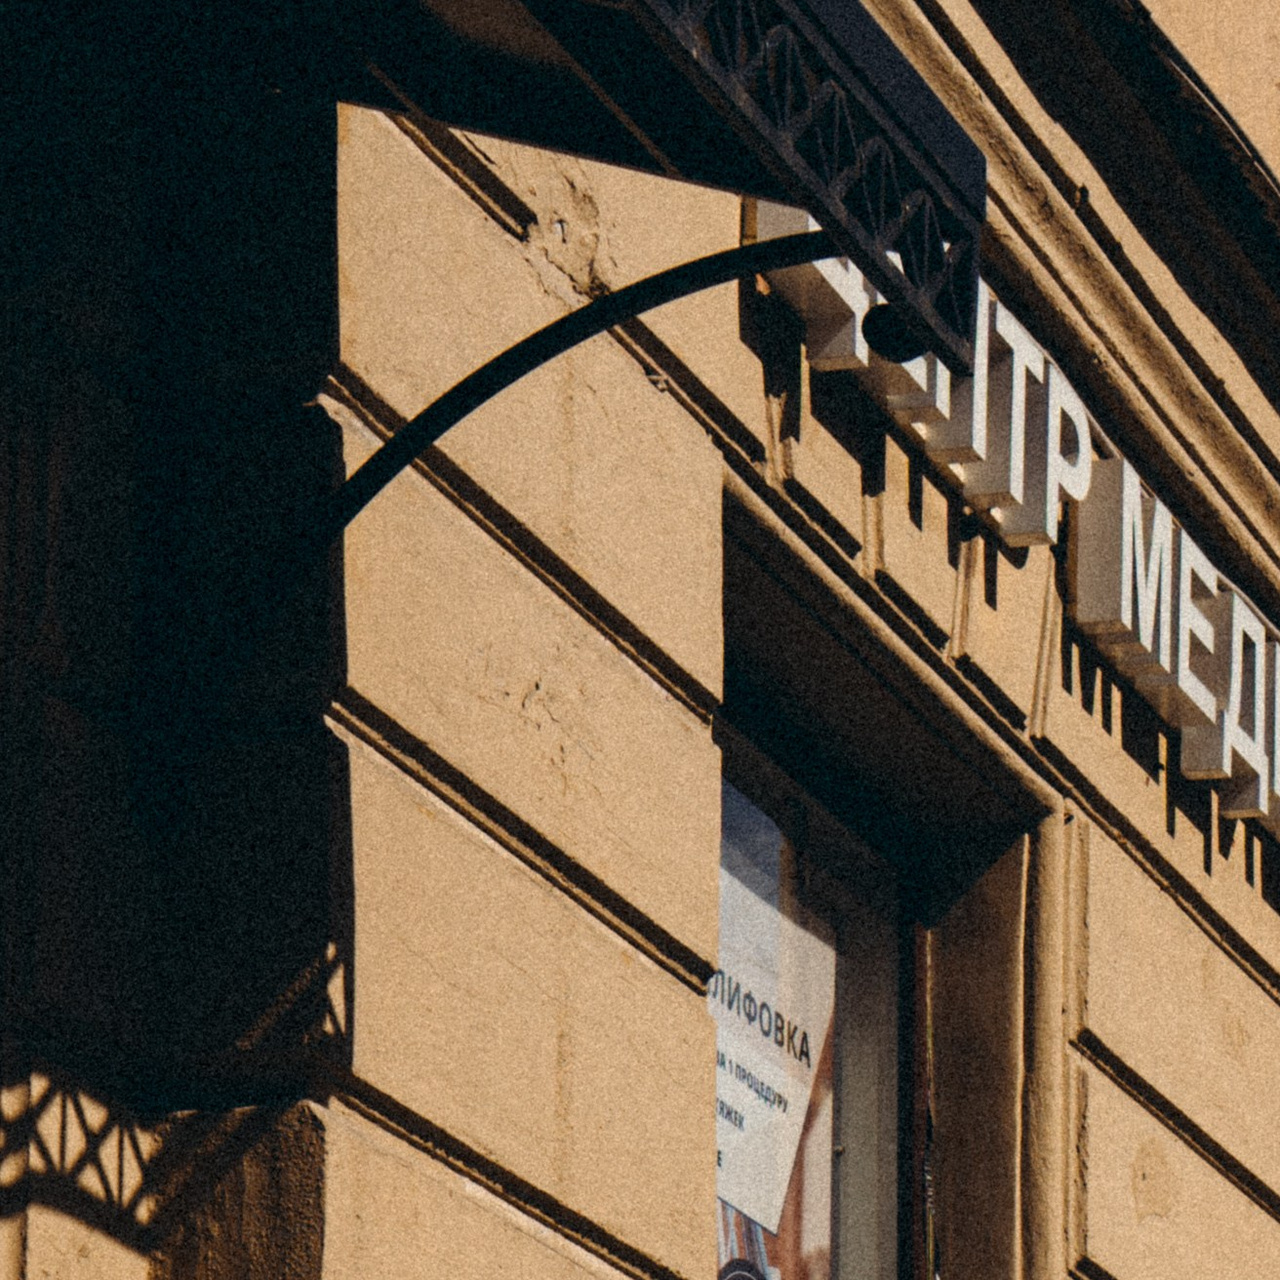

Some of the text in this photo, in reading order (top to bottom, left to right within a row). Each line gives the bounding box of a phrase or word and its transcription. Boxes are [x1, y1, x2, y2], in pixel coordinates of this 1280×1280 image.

[808, 212, 1092, 545] НТР
[709, 968, 811, 1069] ЛИФОВКА
[735, 1063, 788, 1113] ПРОЦЕДУРУ
